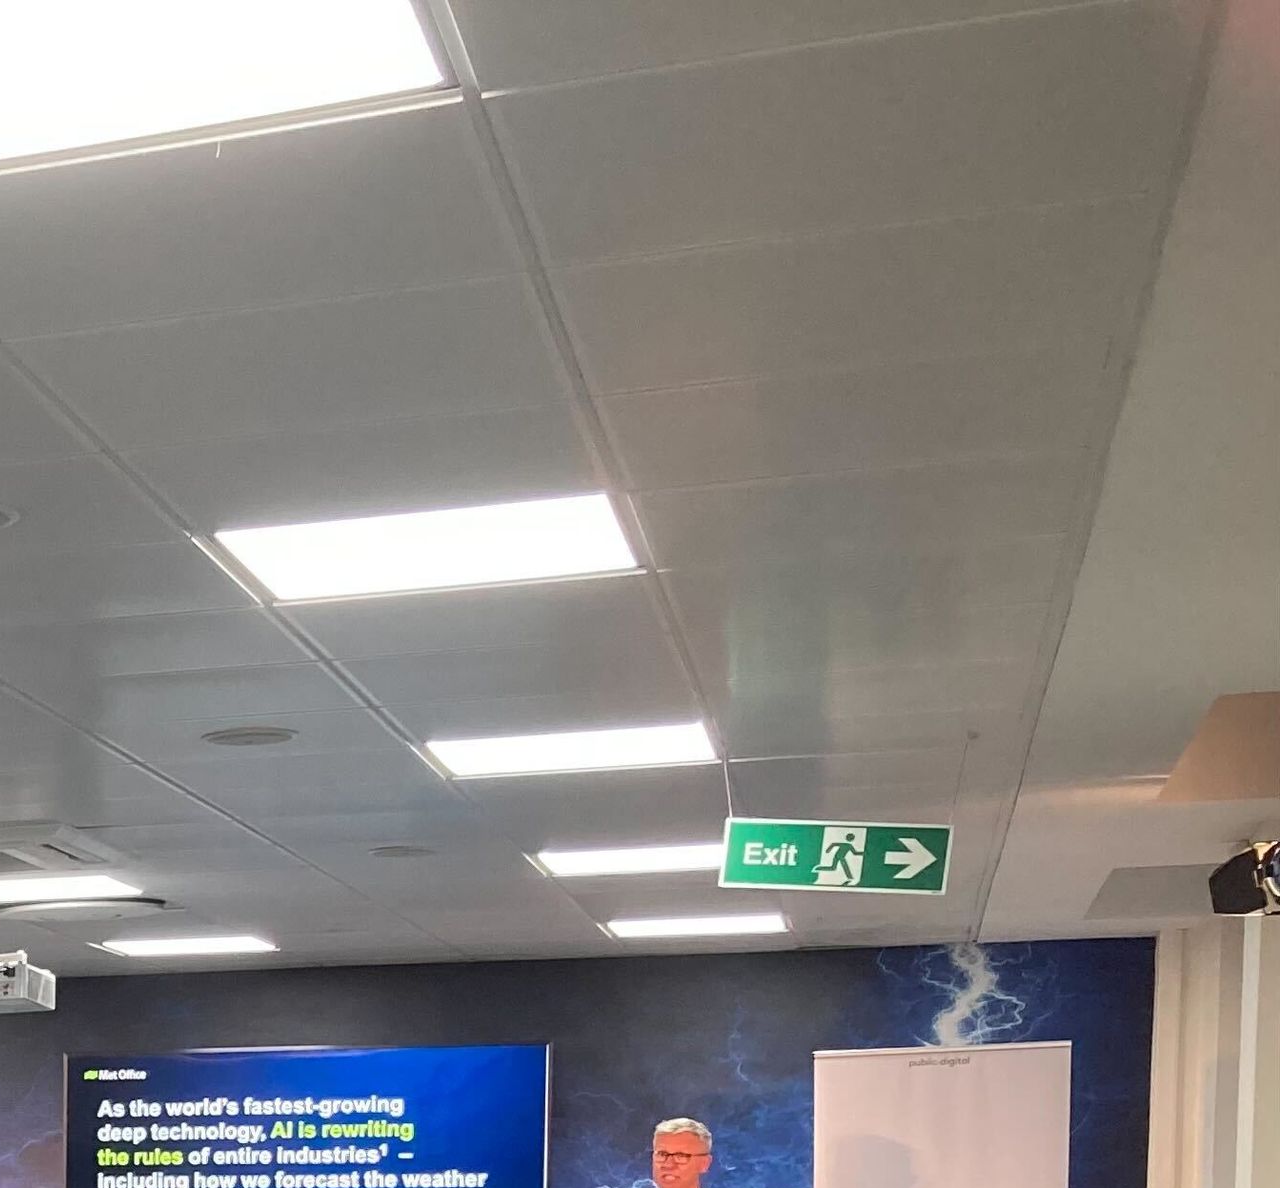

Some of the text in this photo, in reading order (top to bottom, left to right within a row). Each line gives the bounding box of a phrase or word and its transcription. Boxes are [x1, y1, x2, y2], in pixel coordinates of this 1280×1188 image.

[743, 842, 798, 866] Exit
[98, 1069, 118, 1080] Met
[97, 1094, 404, 1118] As the world's fastest-growing
[97, 1119, 415, 1145] deep technology, AI is rewriting
[97, 1148, 130, 1166] the
[133, 1147, 183, 1166] rules
[188, 1146, 211, 1165] of
[213, 1146, 273, 1165] entire
[193, 1171, 237, 1188] how
[274, 1170, 360, 1188] forecast
[363, 1169, 398, 1188] the
[402, 1169, 488, 1188] weather
